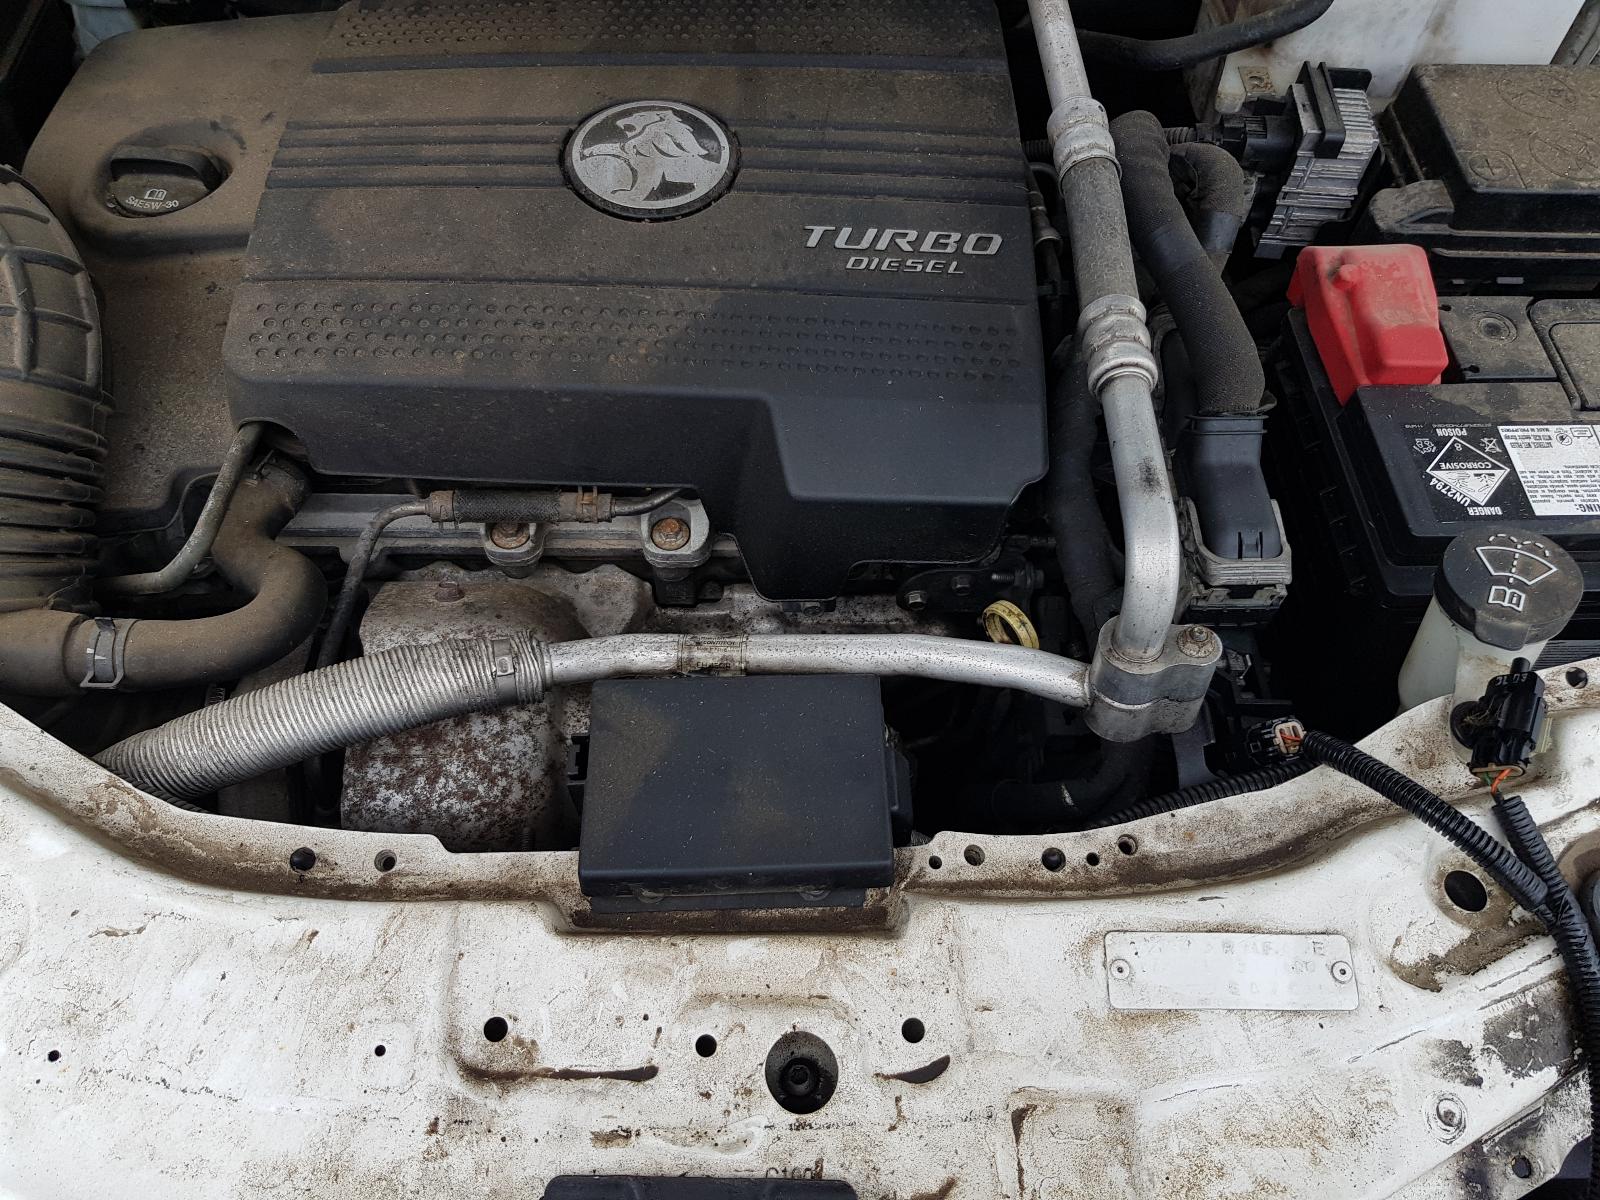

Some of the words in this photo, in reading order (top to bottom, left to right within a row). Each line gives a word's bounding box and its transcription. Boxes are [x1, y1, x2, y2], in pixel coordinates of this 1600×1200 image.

[803, 225, 1004, 256] TURBO
[845, 256, 966, 275] DIESEL
[1435, 427, 1467, 437] POISON
[1454, 442, 1463, 452] 8
[1438, 461, 1492, 470] CORROSIVE
[1429, 477, 1470, 507] UN2794
[1467, 506, 1503, 516] DANGER
